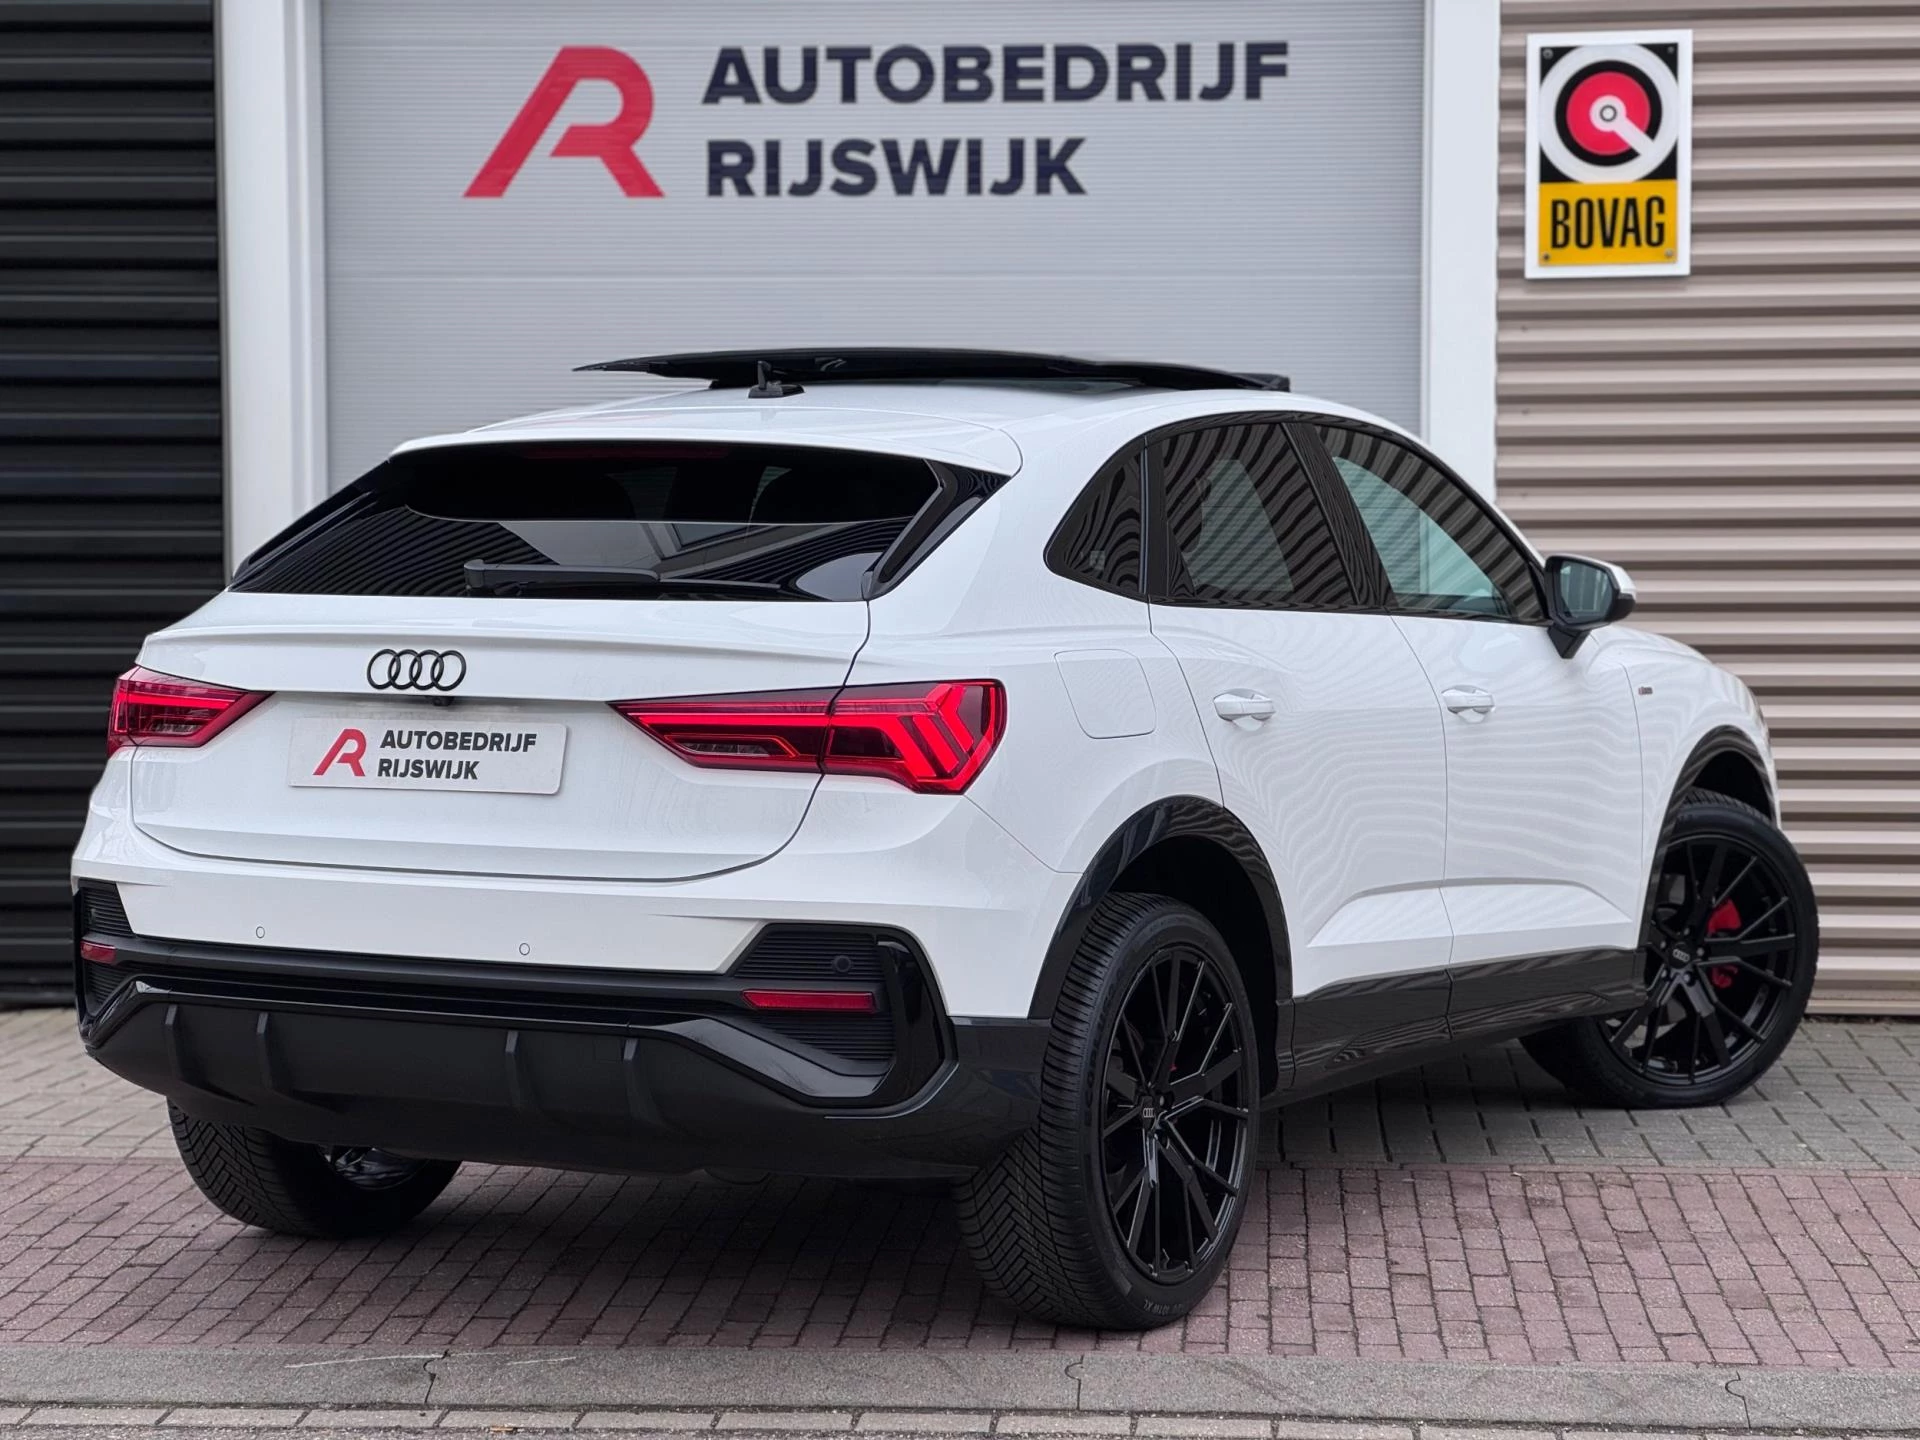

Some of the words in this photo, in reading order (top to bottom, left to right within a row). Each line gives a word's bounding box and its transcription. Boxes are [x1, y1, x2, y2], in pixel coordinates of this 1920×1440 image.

[702, 42, 1289, 104] AUTOBEDRIJF
[707, 137, 1086, 197] RIJSWIJK
[1551, 196, 1665, 248] BOVAG
[379, 729, 538, 753] AUTOBEDRIJF
[377, 758, 480, 780] RIJSWIJK
